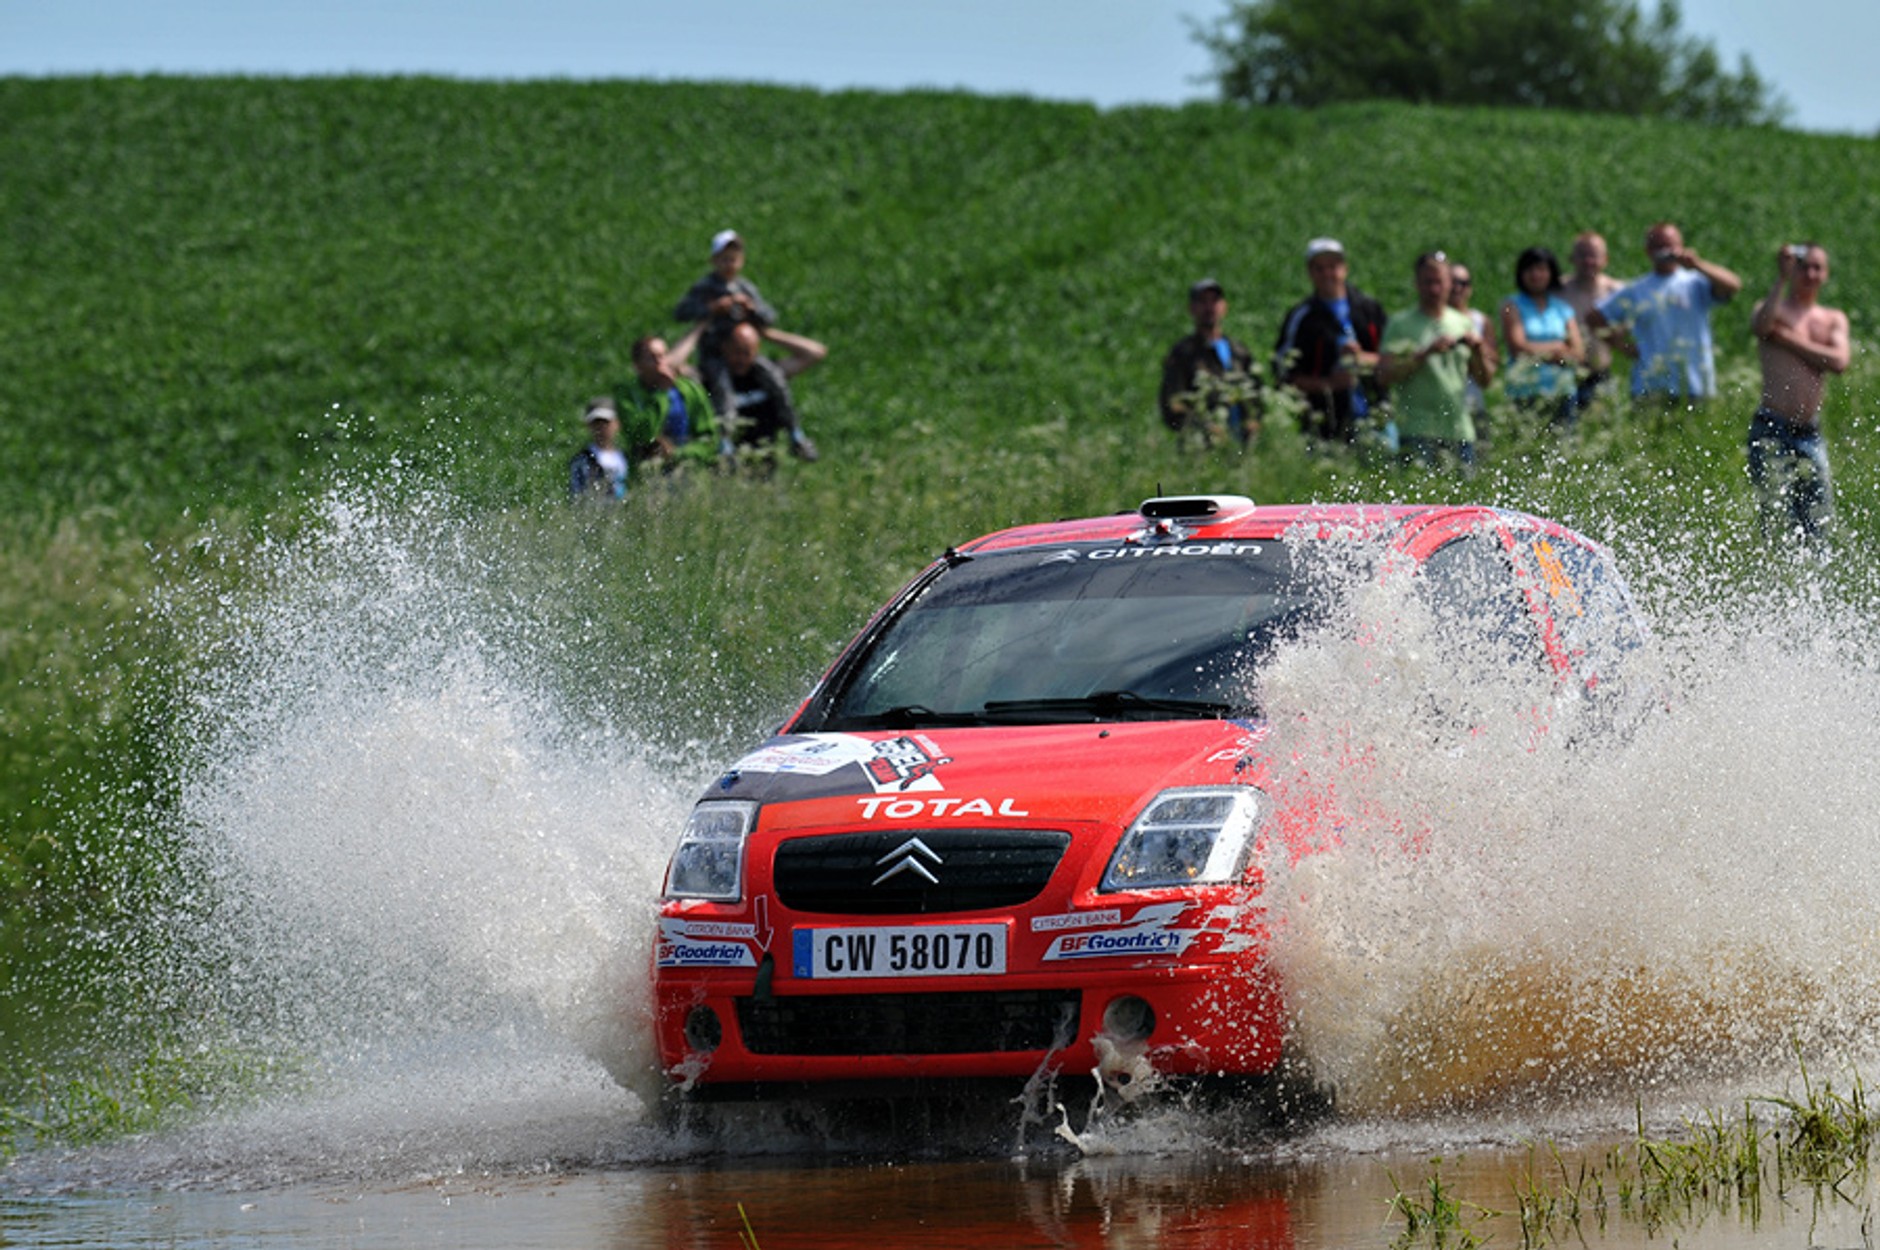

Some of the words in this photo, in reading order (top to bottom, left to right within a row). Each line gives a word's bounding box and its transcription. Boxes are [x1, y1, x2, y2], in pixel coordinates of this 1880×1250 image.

[856, 796, 1030, 820] TOTAL
[1085, 911, 1119, 925] BANK
[725, 924, 753, 936] BANK
[1059, 931, 1181, 953] BFGoodrich
[658, 944, 745, 959] BFGoodrich
[825, 934, 876, 972] CW
[889, 932, 994, 971] 58070
